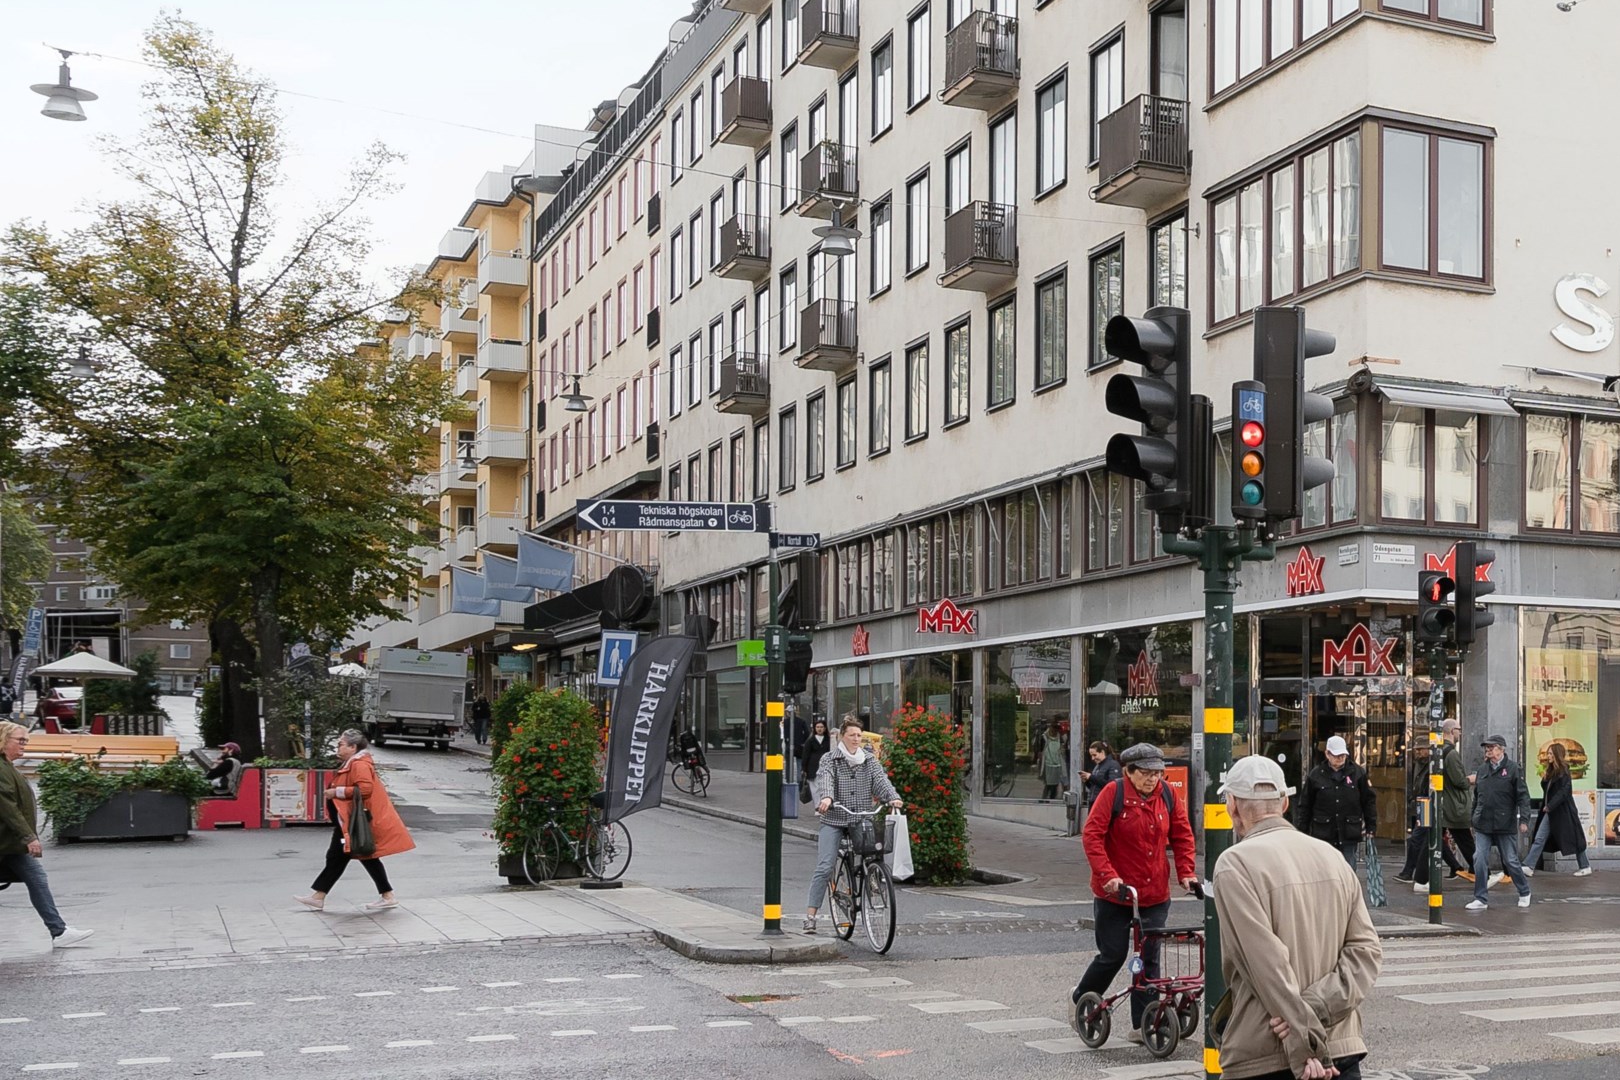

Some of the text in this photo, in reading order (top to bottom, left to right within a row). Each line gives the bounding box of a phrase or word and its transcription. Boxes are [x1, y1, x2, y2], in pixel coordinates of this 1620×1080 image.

[602, 505, 723, 517] 1,4 Tekniska högskolan
[602, 517, 616, 527] 0,4
[639, 516, 704, 528] Rådmansgatan
[1287, 546, 1325, 596] MAX
[919, 598, 976, 634] MAX
[852, 624, 870, 656] MAX
[1323, 623, 1398, 676] MAX
[1128, 649, 1158, 696] MAX
[624, 661, 669, 803] HÅRKLIPPET
